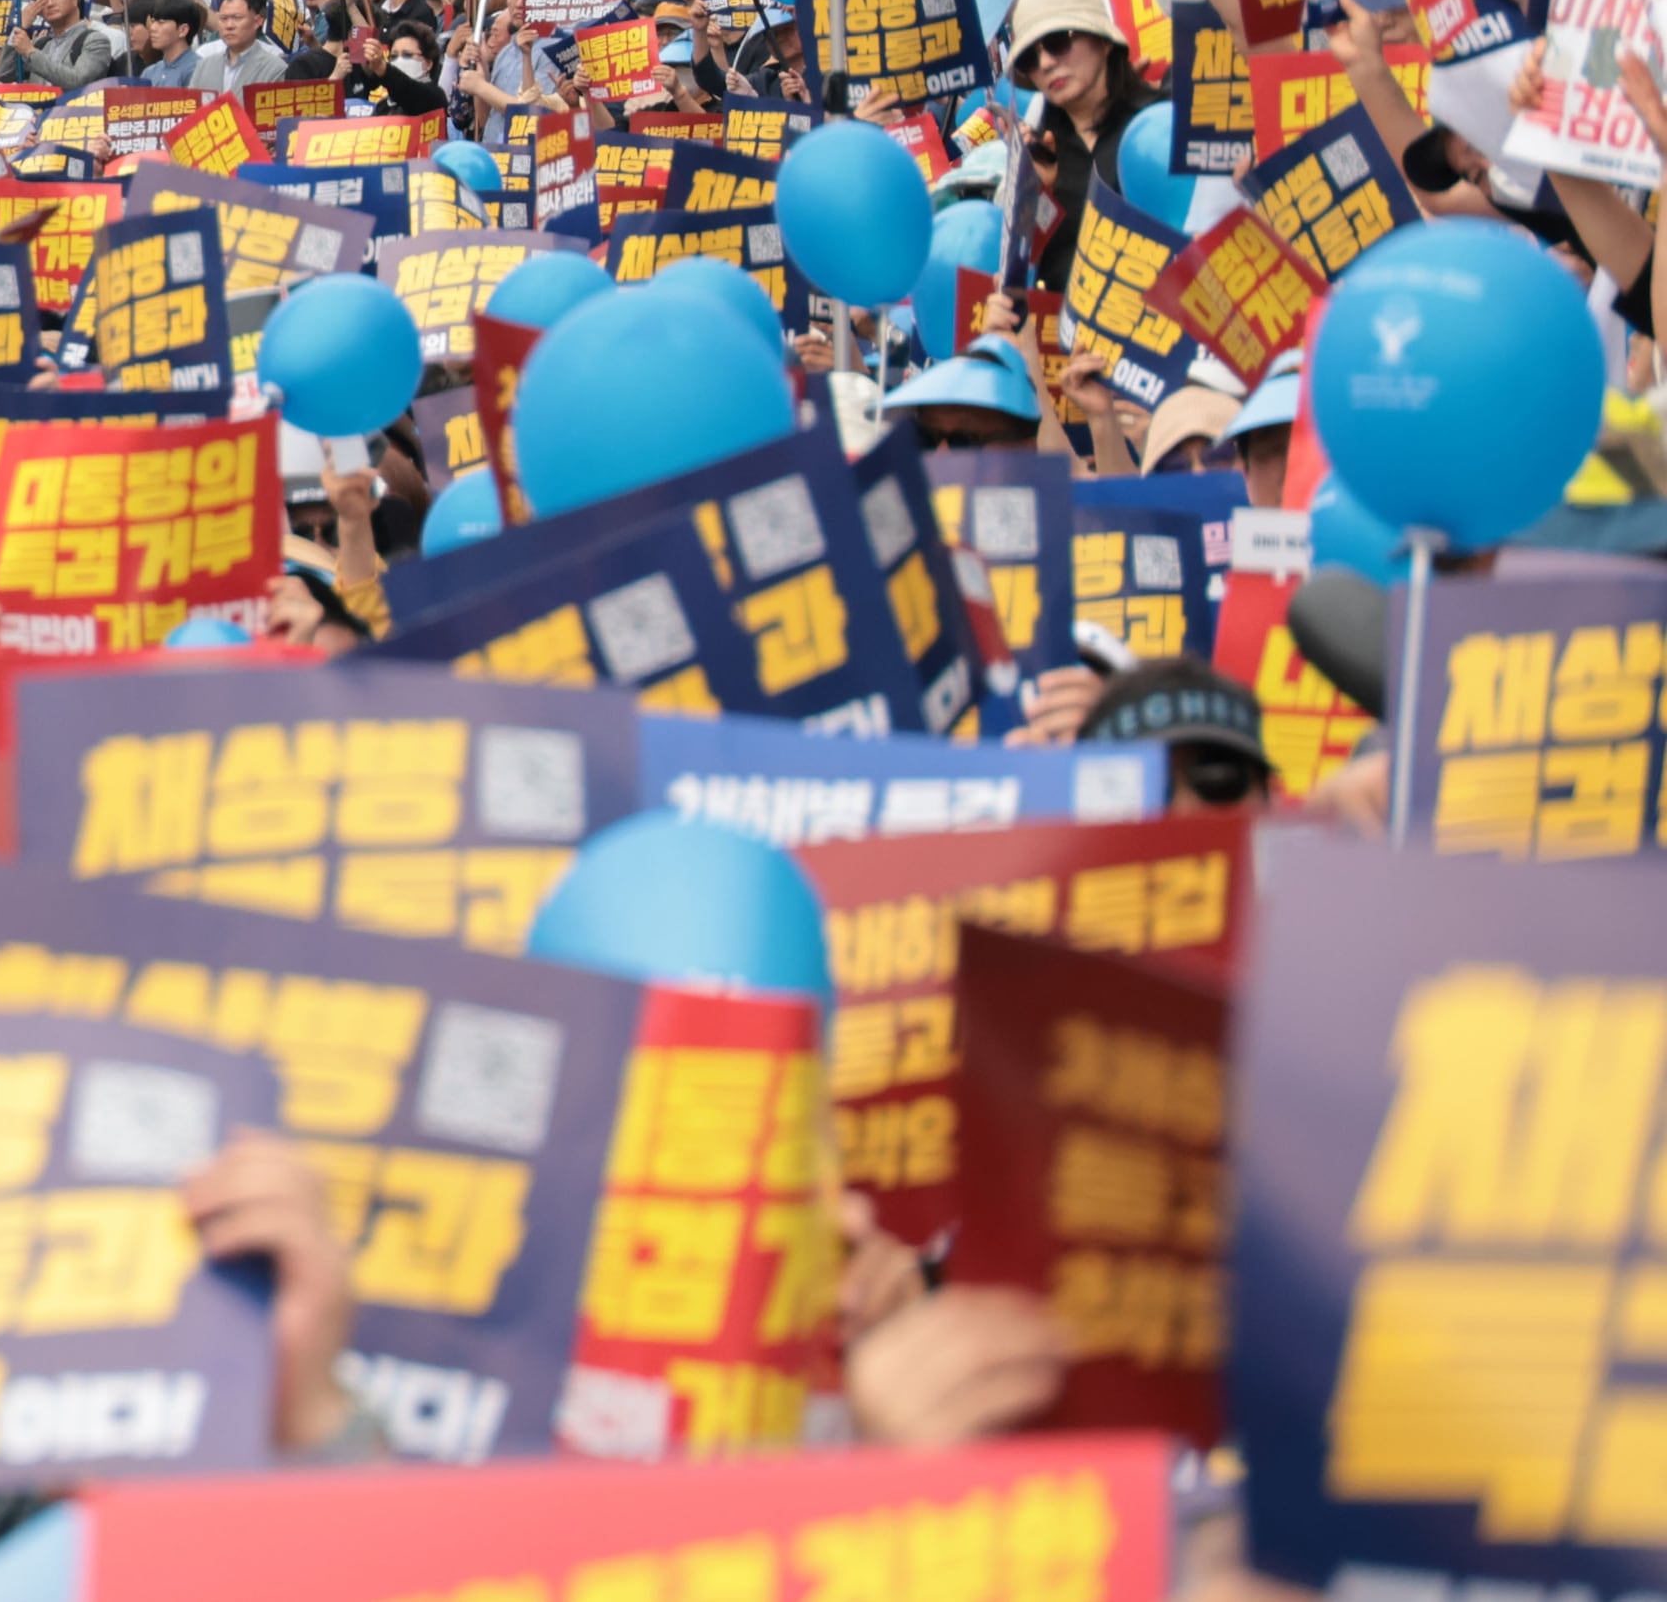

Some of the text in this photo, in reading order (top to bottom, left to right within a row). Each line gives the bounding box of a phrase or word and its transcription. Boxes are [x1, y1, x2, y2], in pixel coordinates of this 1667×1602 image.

[578, 25, 649, 61] 대통령의
[614, 51, 650, 78] 거부
[107, 104, 144, 120] 윤석열
[255, 83, 336, 110] 대통령의
[2, 431, 259, 529] 대통령의
[126, 504, 255, 590] 거부
